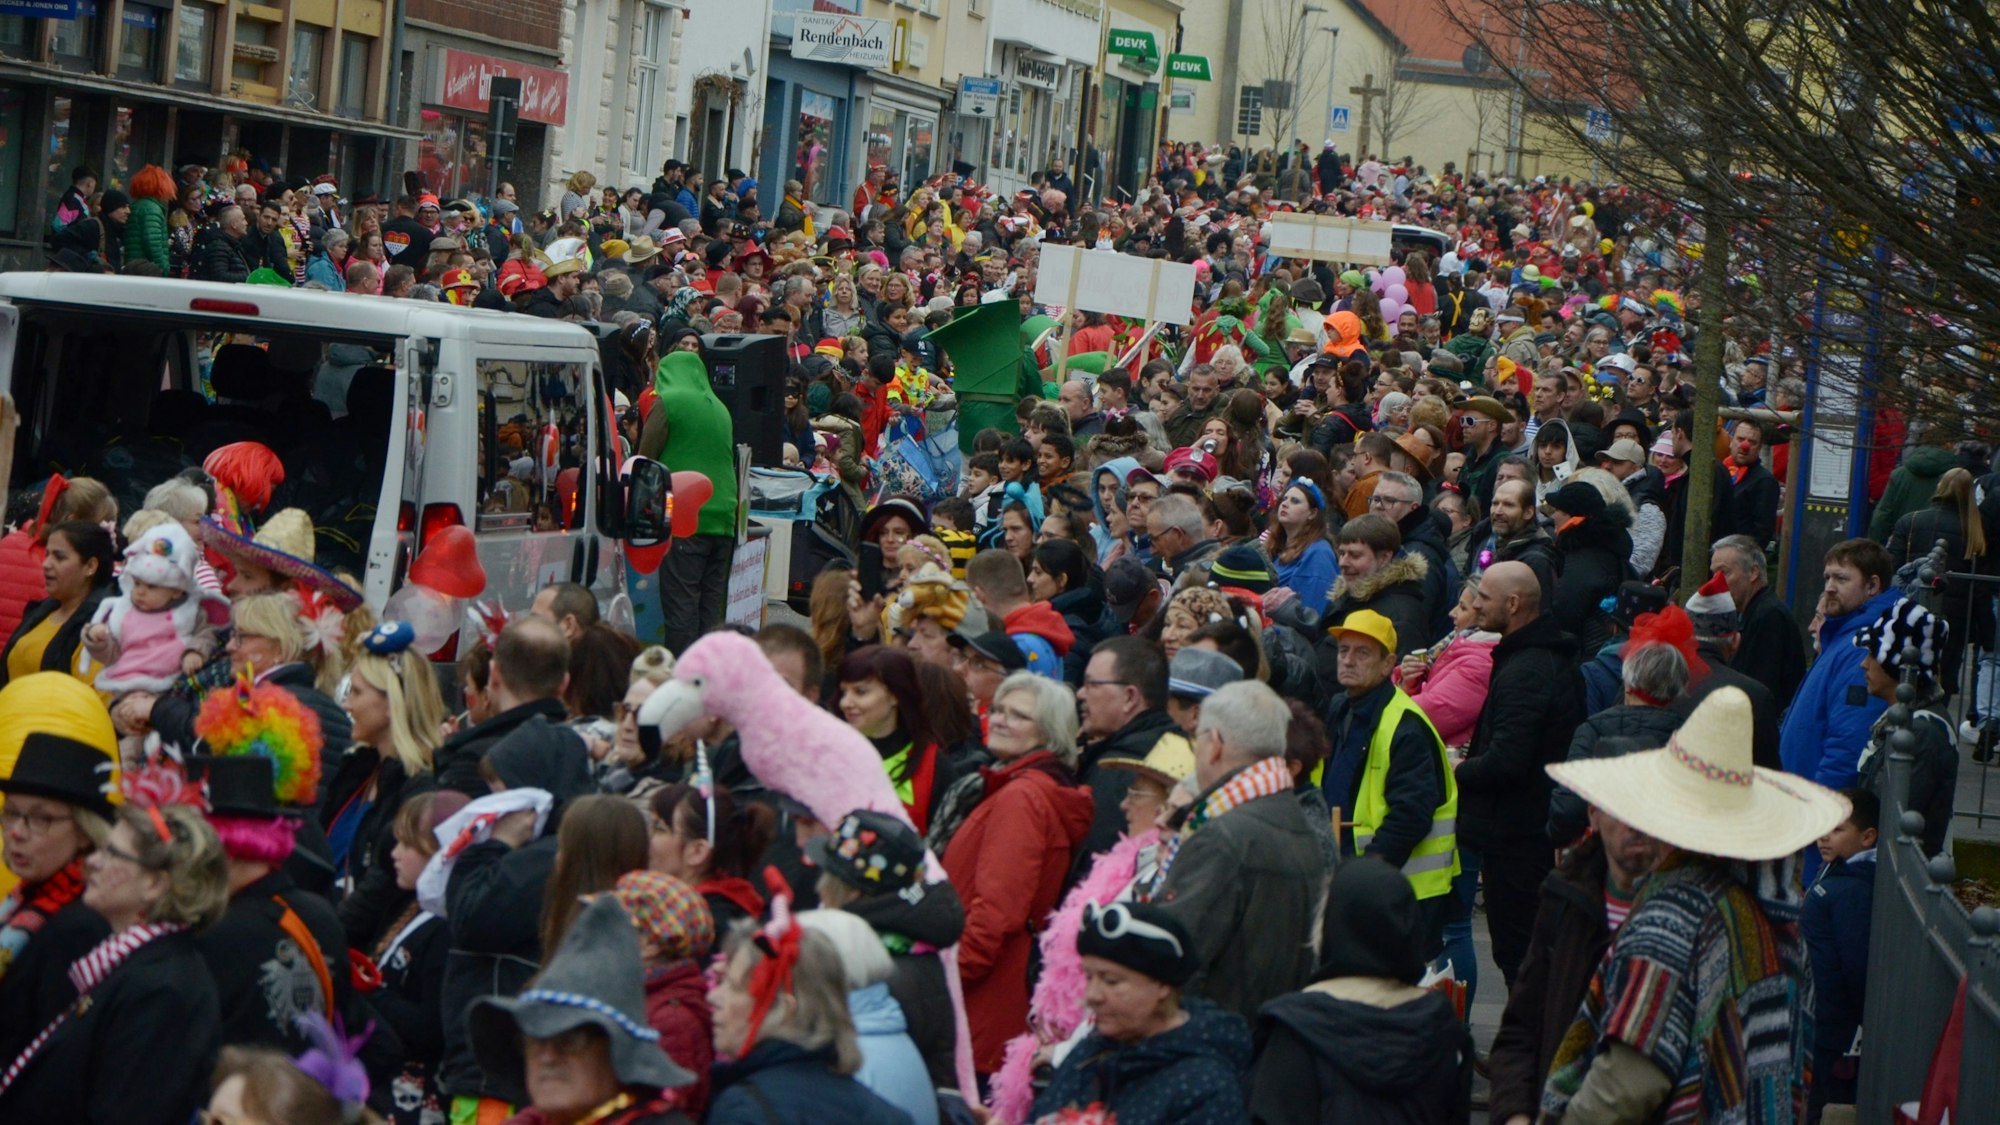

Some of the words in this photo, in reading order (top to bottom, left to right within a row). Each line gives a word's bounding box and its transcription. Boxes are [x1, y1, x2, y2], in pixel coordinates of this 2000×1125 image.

[800, 28, 883, 50] Rendenbach
[1115, 37, 1148, 50] DEVK
[849, 51, 885, 61] HEIZUNG
[1172, 61, 1202, 73] DEVK
